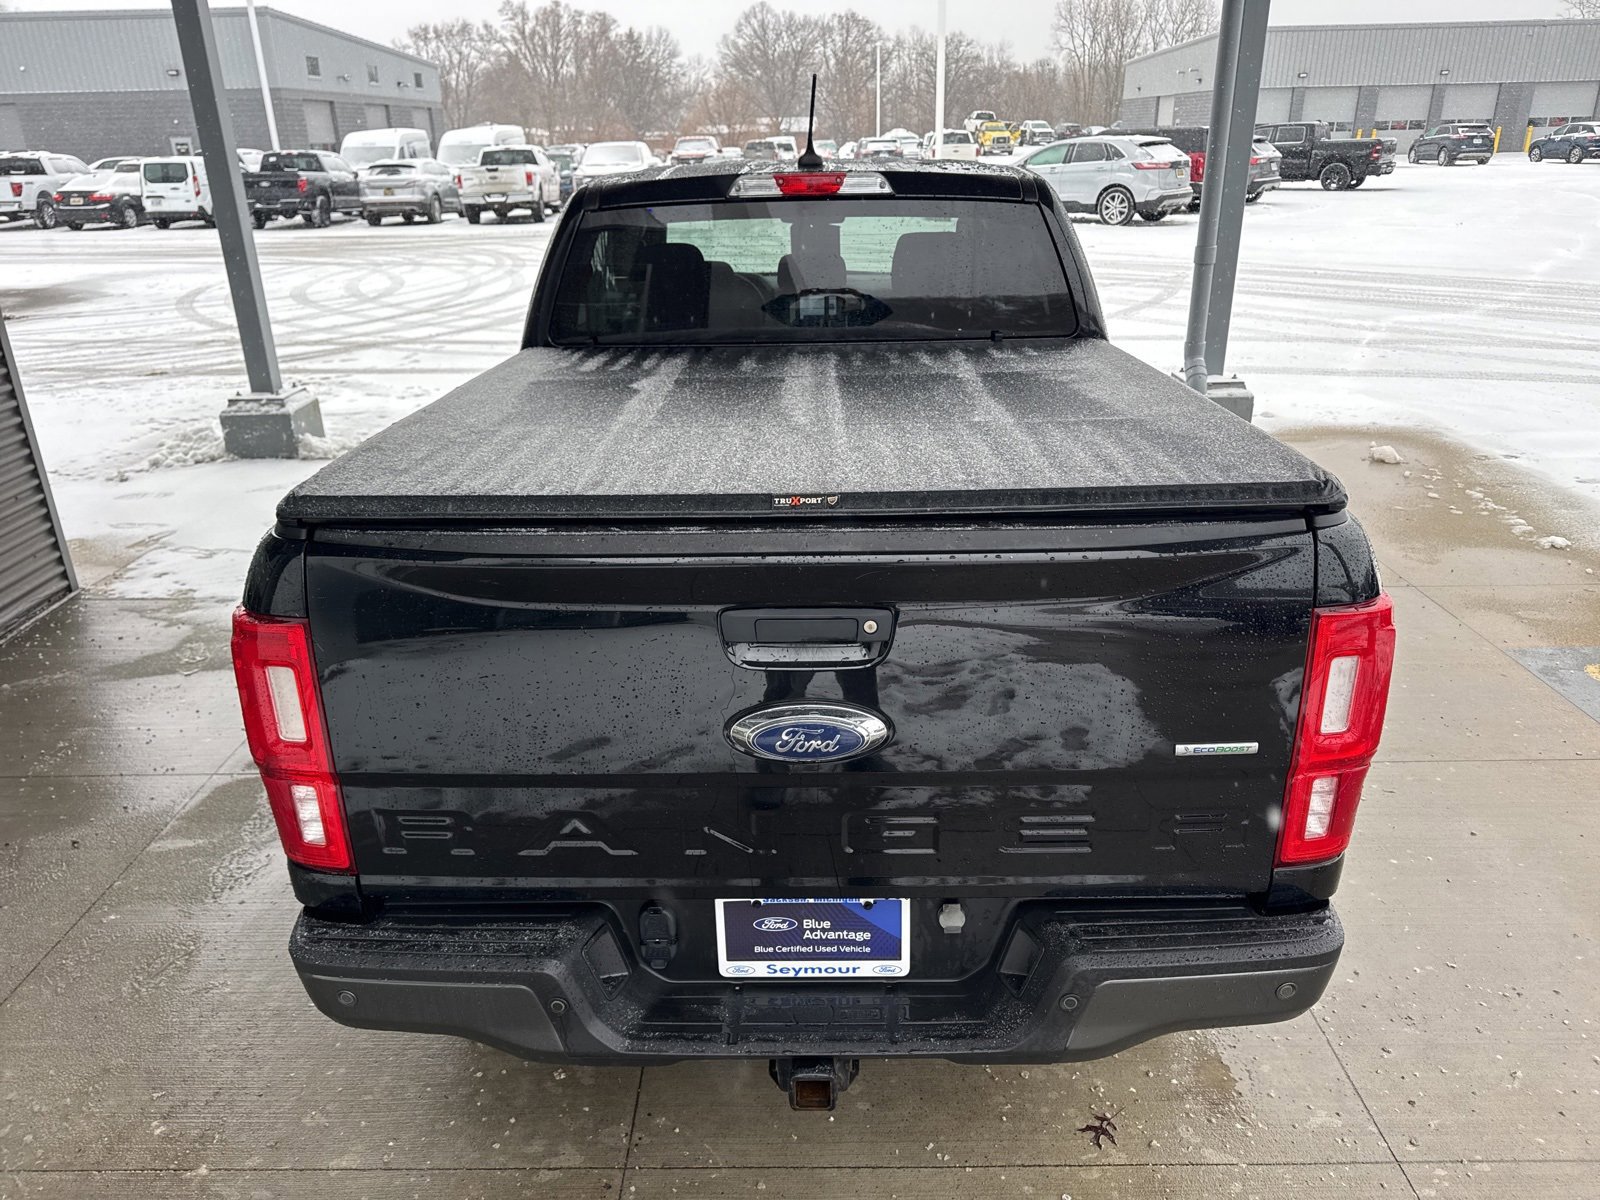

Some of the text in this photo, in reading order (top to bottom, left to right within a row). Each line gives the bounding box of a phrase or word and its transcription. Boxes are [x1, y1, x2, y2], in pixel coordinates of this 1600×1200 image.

[774, 496, 822, 506] TRUXPORT
[775, 727, 840, 753] Ford
[761, 919, 789, 930] Ford
[803, 919, 831, 929] Blue
[803, 930, 871, 941] Advantage
[754, 945, 871, 953] Blue Certified Used Vehicle
[766, 963, 861, 977] Seymour
